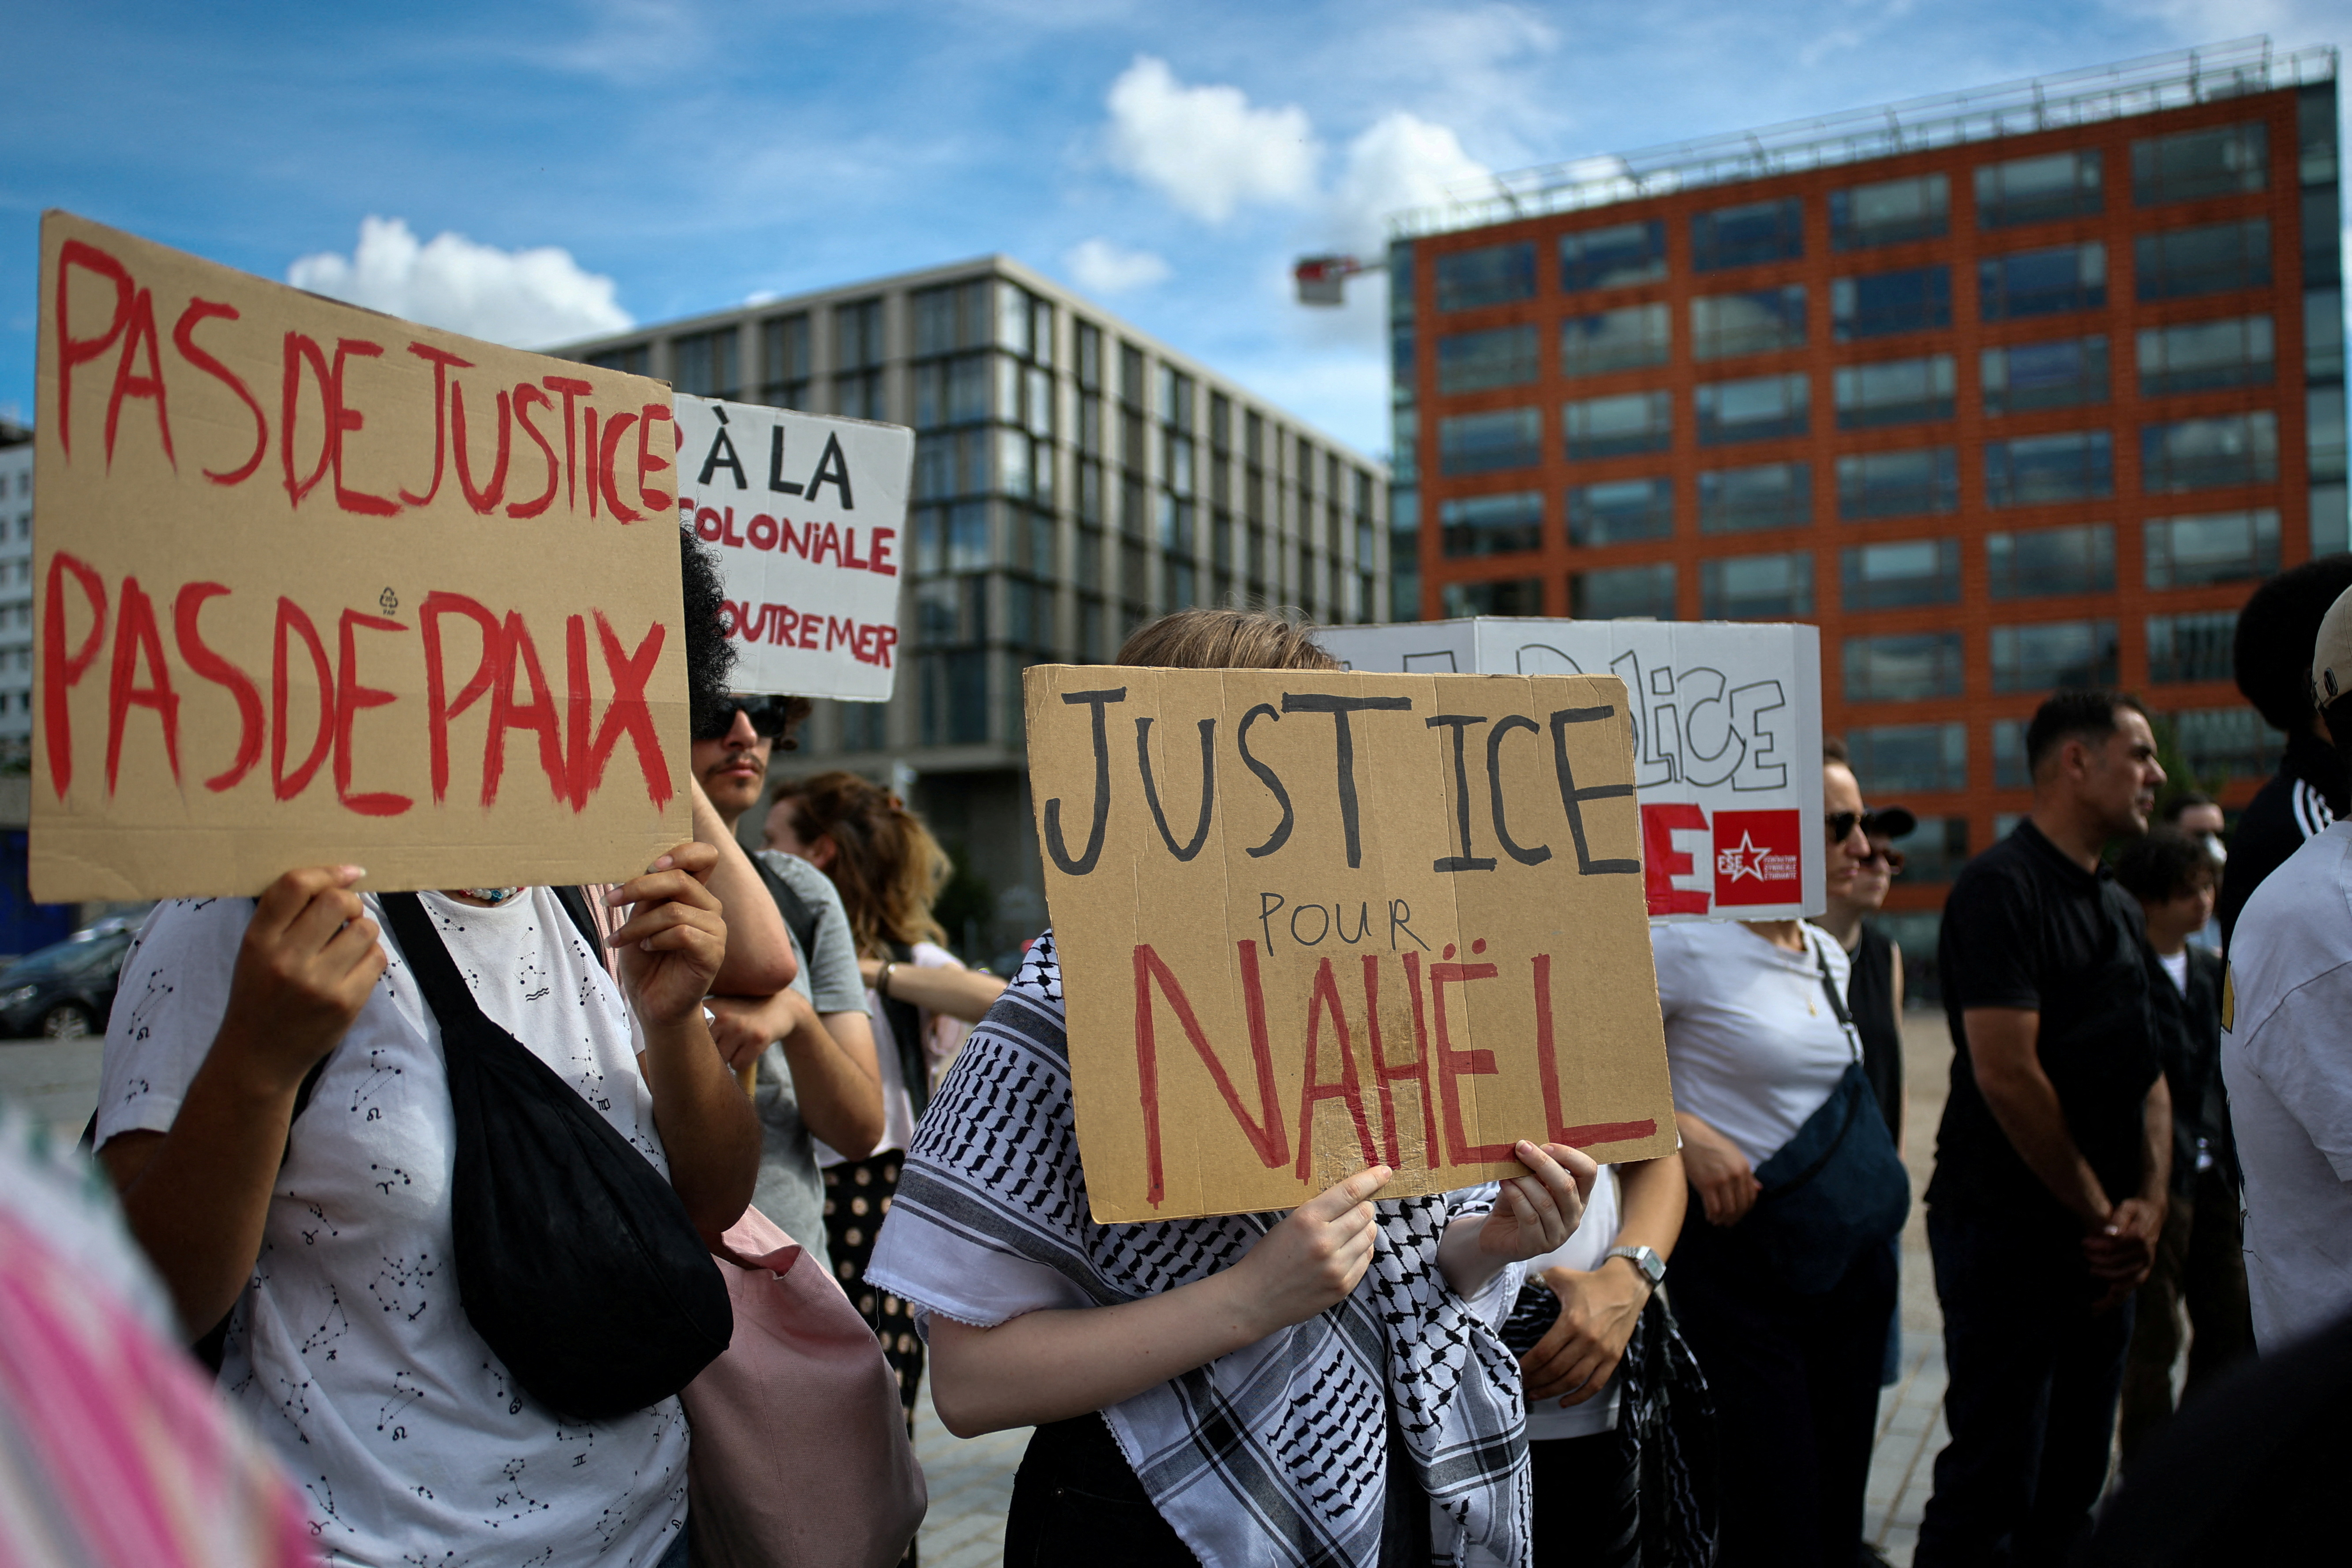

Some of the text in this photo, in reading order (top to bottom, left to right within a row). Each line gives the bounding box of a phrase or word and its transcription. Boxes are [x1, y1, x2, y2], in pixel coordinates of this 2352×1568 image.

[57, 239, 674, 525] PAS DE JUSTICE
[697, 405, 748, 490] À
[769, 425, 854, 510] LA
[43, 550, 674, 817] PAS DE PAIX
[1044, 686, 1641, 876] JUSTICE
[1258, 892, 1432, 957] POUR
